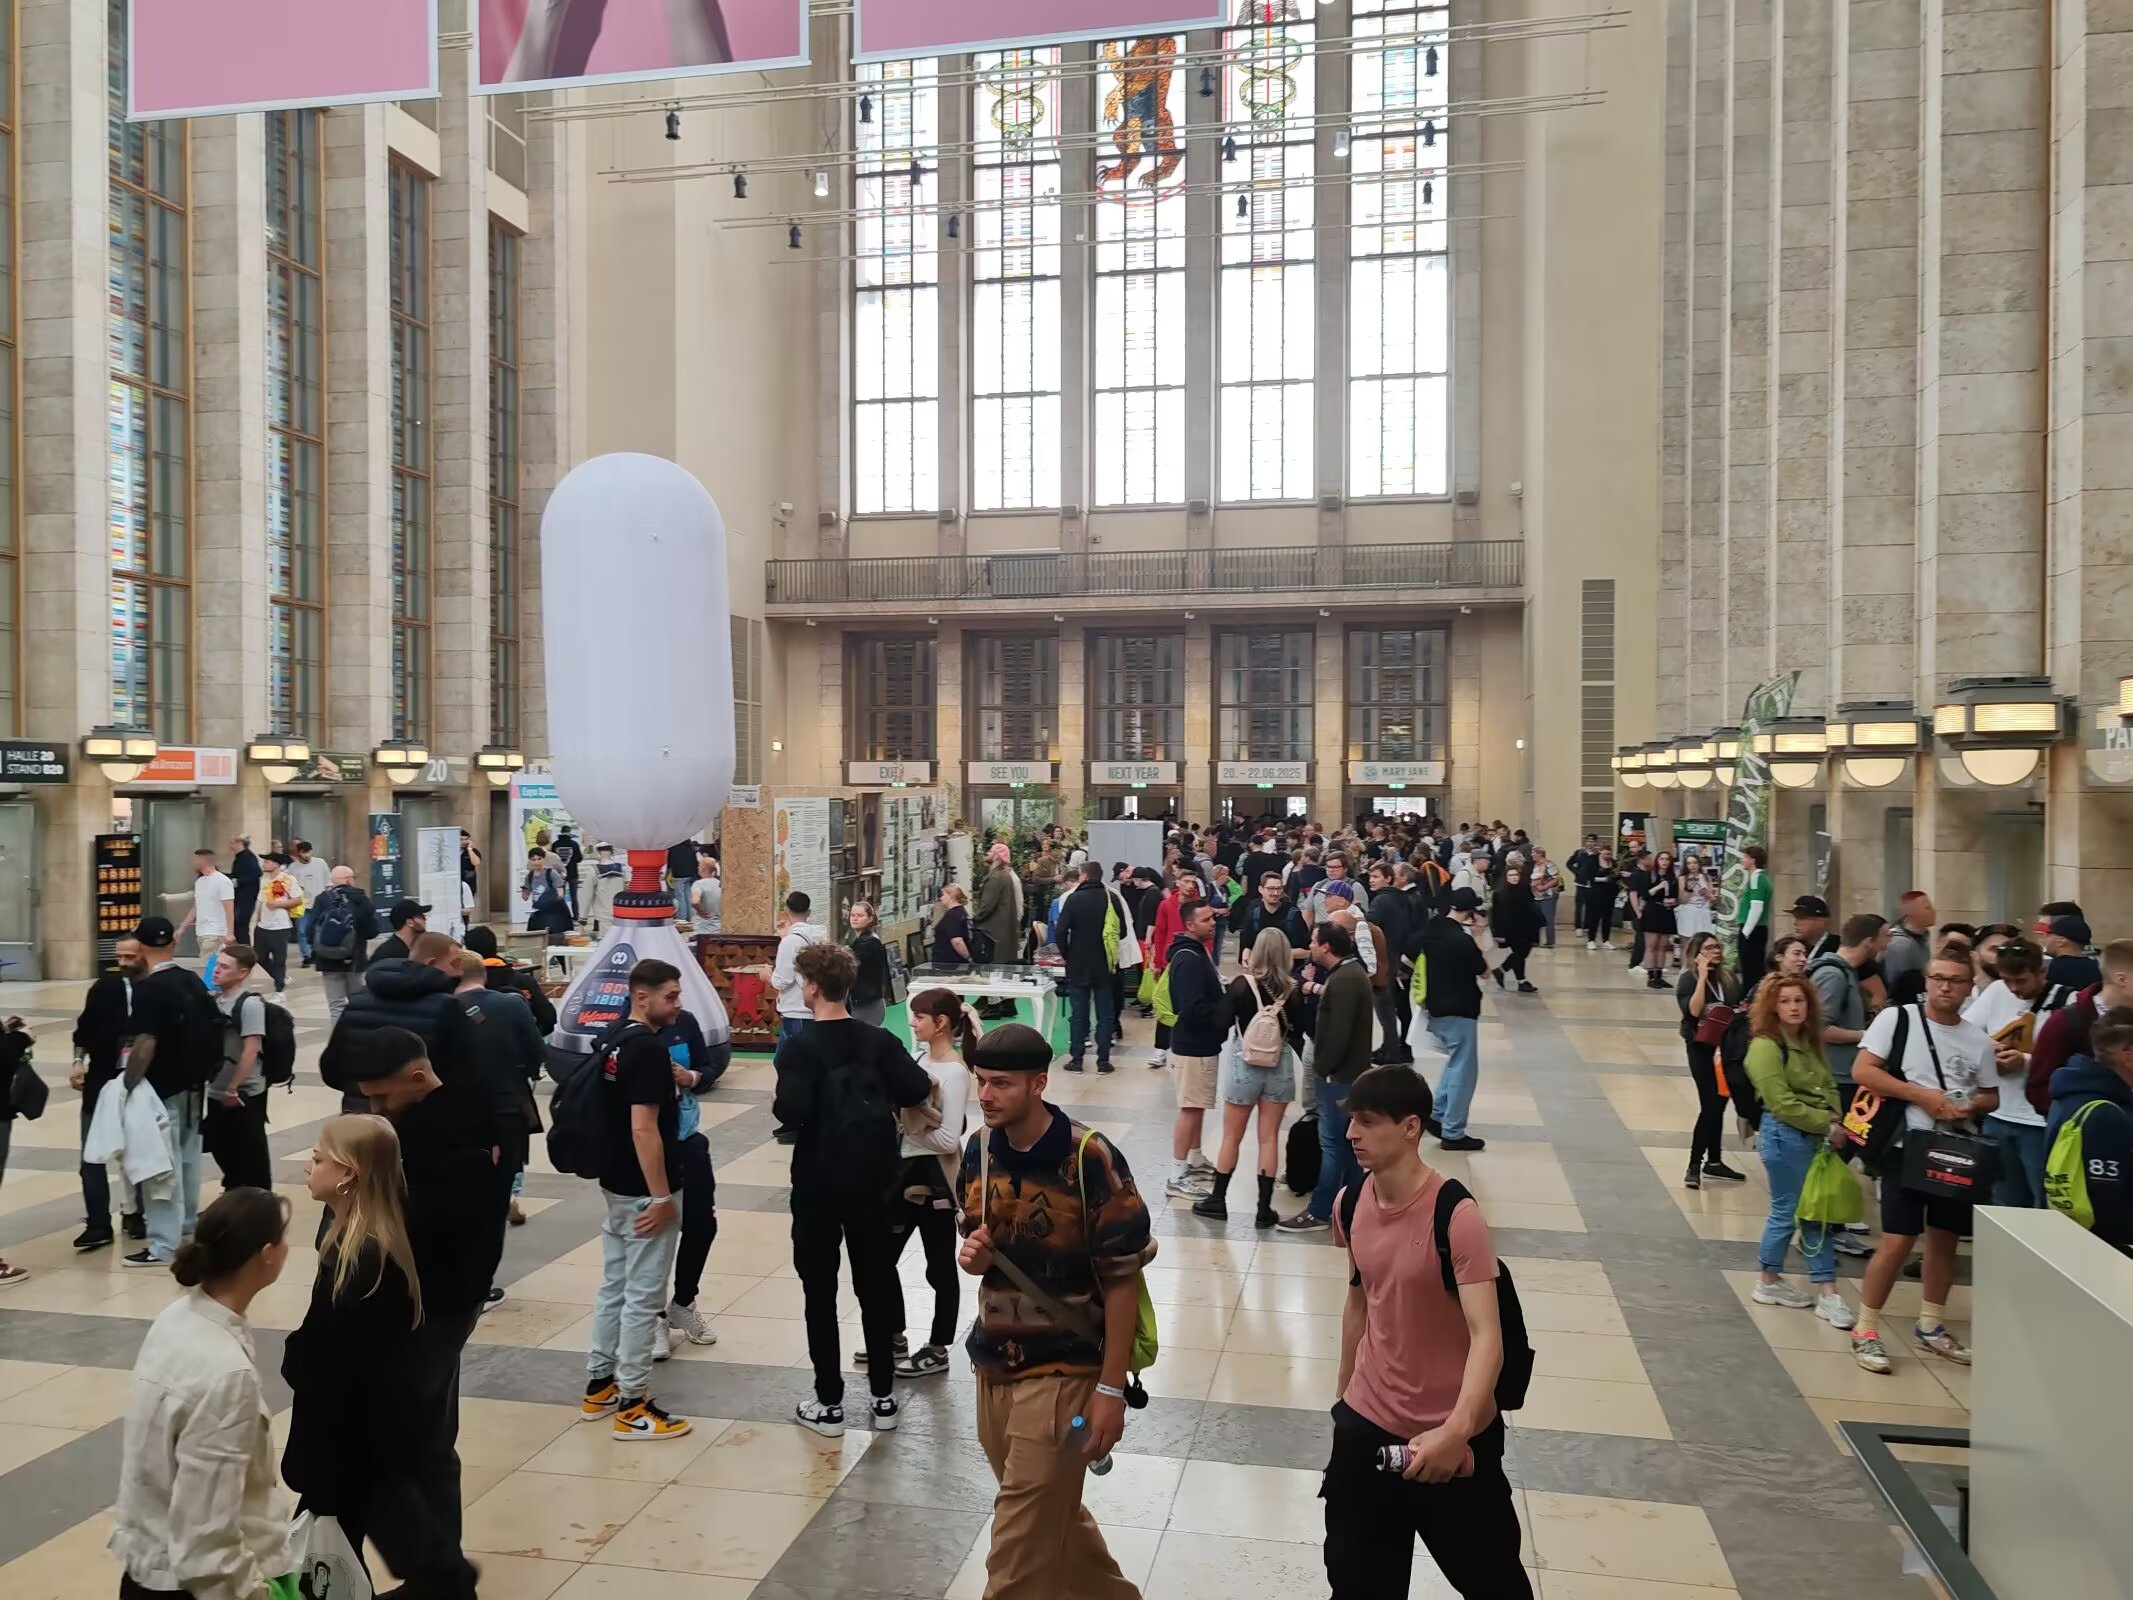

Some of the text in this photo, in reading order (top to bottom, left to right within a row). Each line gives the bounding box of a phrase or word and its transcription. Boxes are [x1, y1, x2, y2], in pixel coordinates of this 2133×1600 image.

[2105, 727, 2133, 751] PA
[7, 751, 55, 761] HALLE 20
[7, 764, 41, 774] STAND
[427, 759, 447, 781] 20
[991, 767, 1029, 779] SEE YOU
[1108, 767, 1159, 779] NEXT YEAR
[1249, 767, 1301, 779] 22.06.2025
[1382, 767, 1429, 776] MARY JANE
[2088, 1159, 2119, 1176] 83
